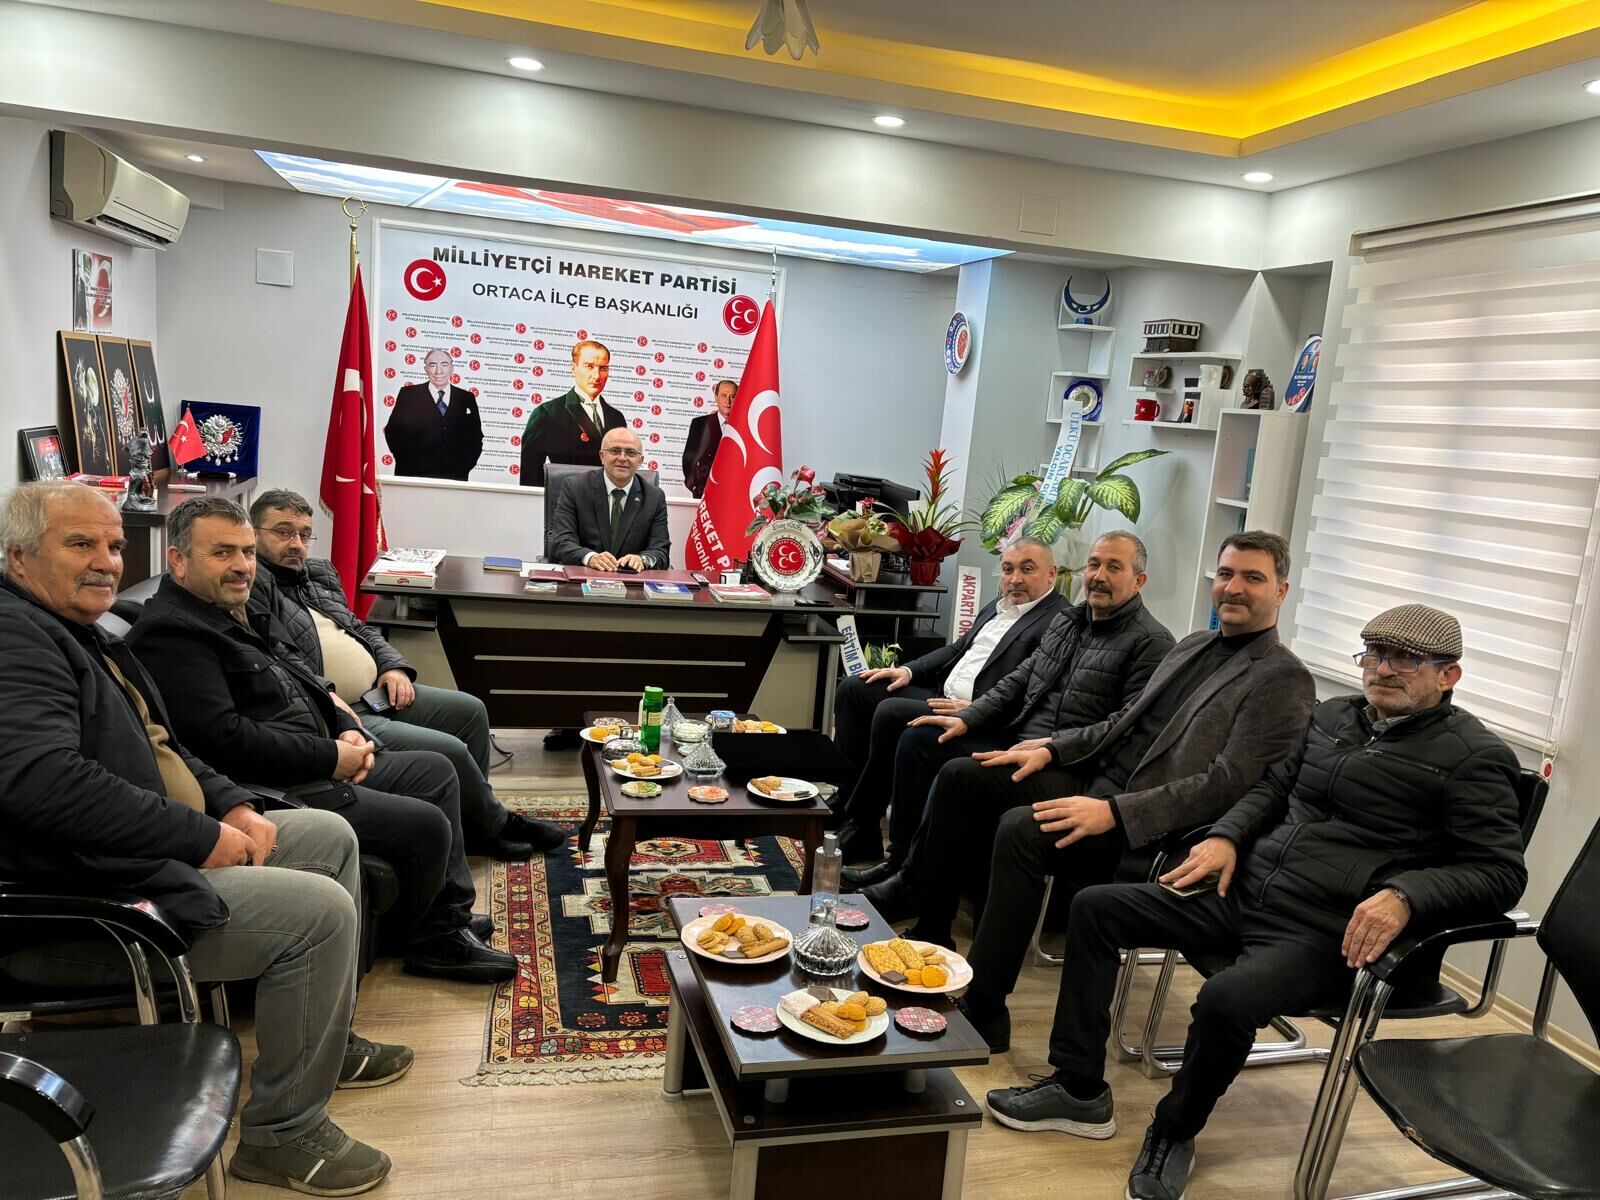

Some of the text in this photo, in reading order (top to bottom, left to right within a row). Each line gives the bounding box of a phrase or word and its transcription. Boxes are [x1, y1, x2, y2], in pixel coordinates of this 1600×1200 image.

[433, 245, 737, 295] MİLLİYETÇİ HAREKET PARTİSİ
[472, 283, 698, 319] ORTACA İLÇE BAŞKANLIĞI
[699, 495, 724, 551] REKET
[958, 574, 976, 637] AKPARTİ OR
